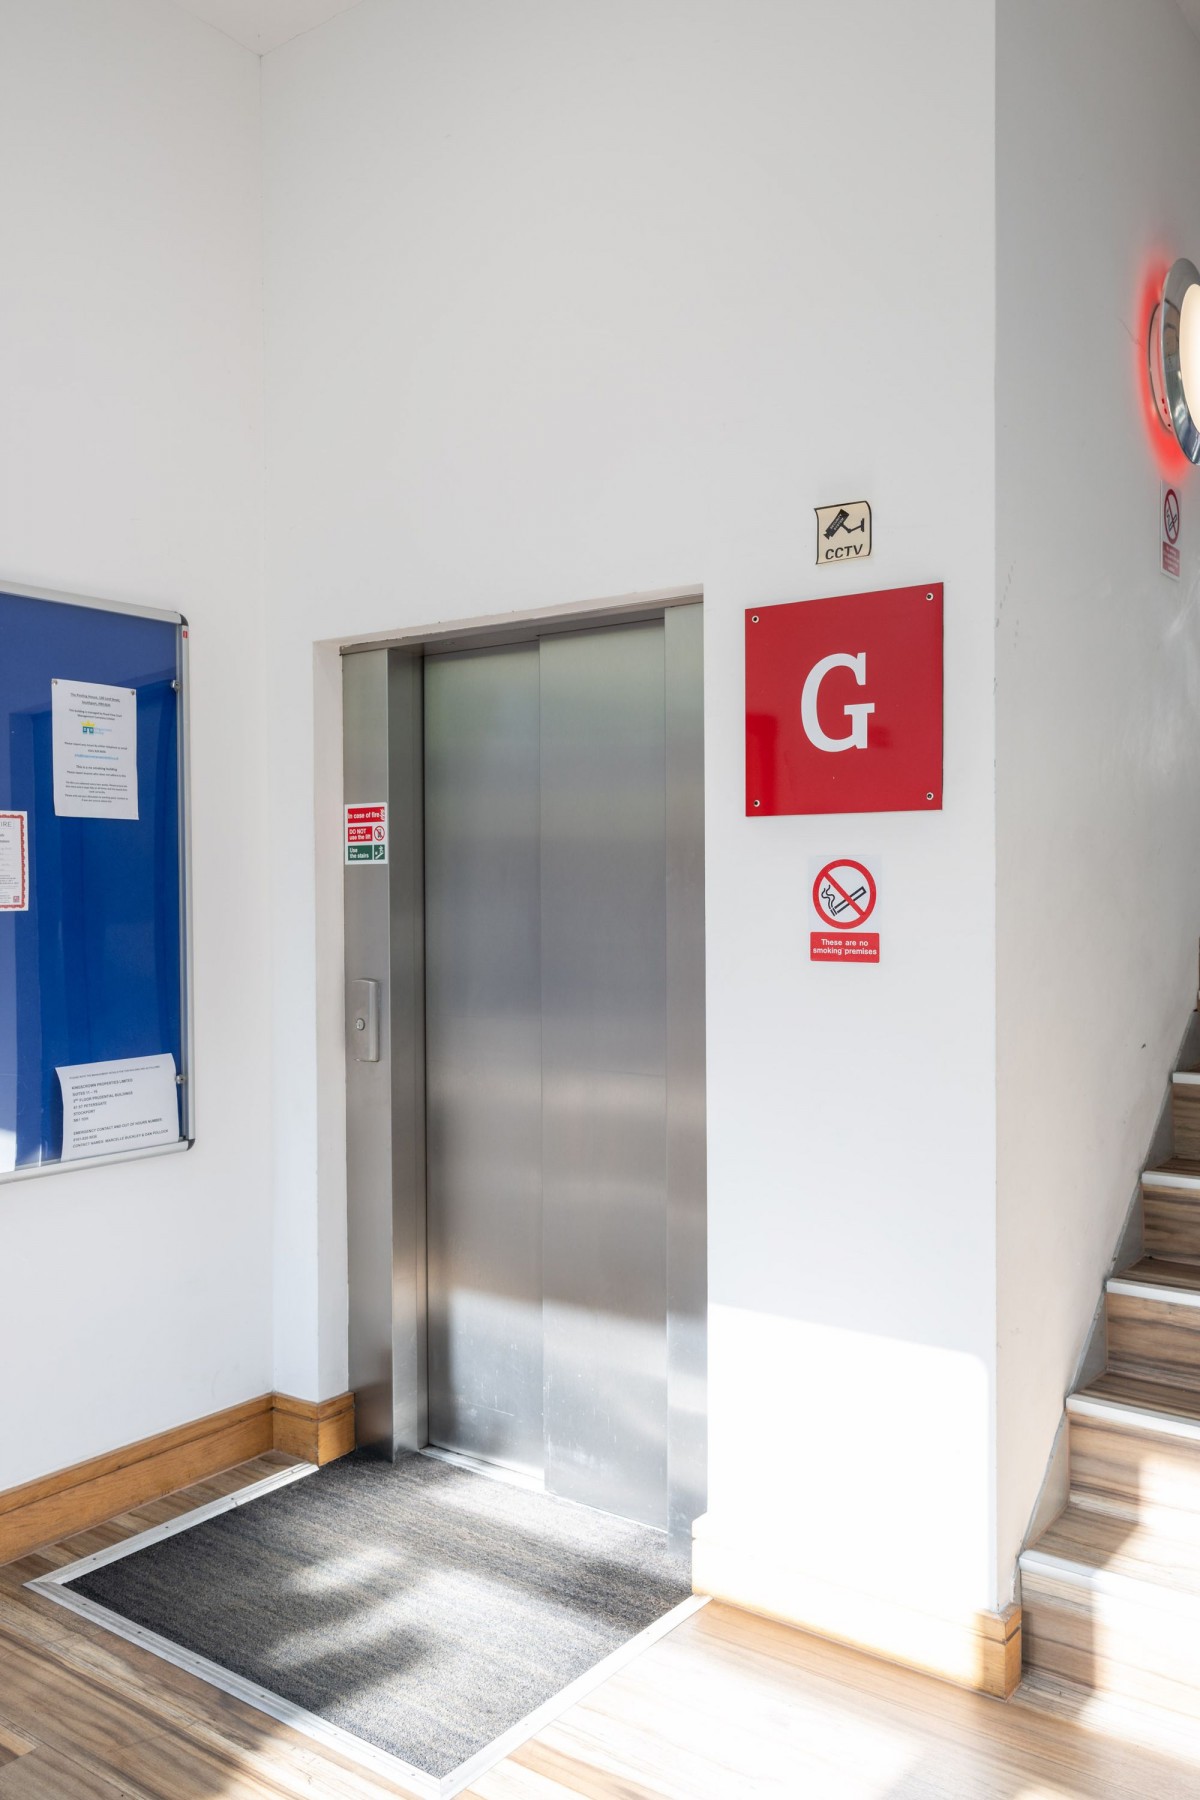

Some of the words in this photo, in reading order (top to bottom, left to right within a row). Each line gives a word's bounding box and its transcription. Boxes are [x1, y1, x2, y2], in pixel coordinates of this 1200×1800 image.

[825, 543, 863, 560] CCTV
[801, 652, 875, 752] G
[821, 938, 843, 946] These
[812, 947, 842, 955] smoking
[844, 947, 877, 955] premises
